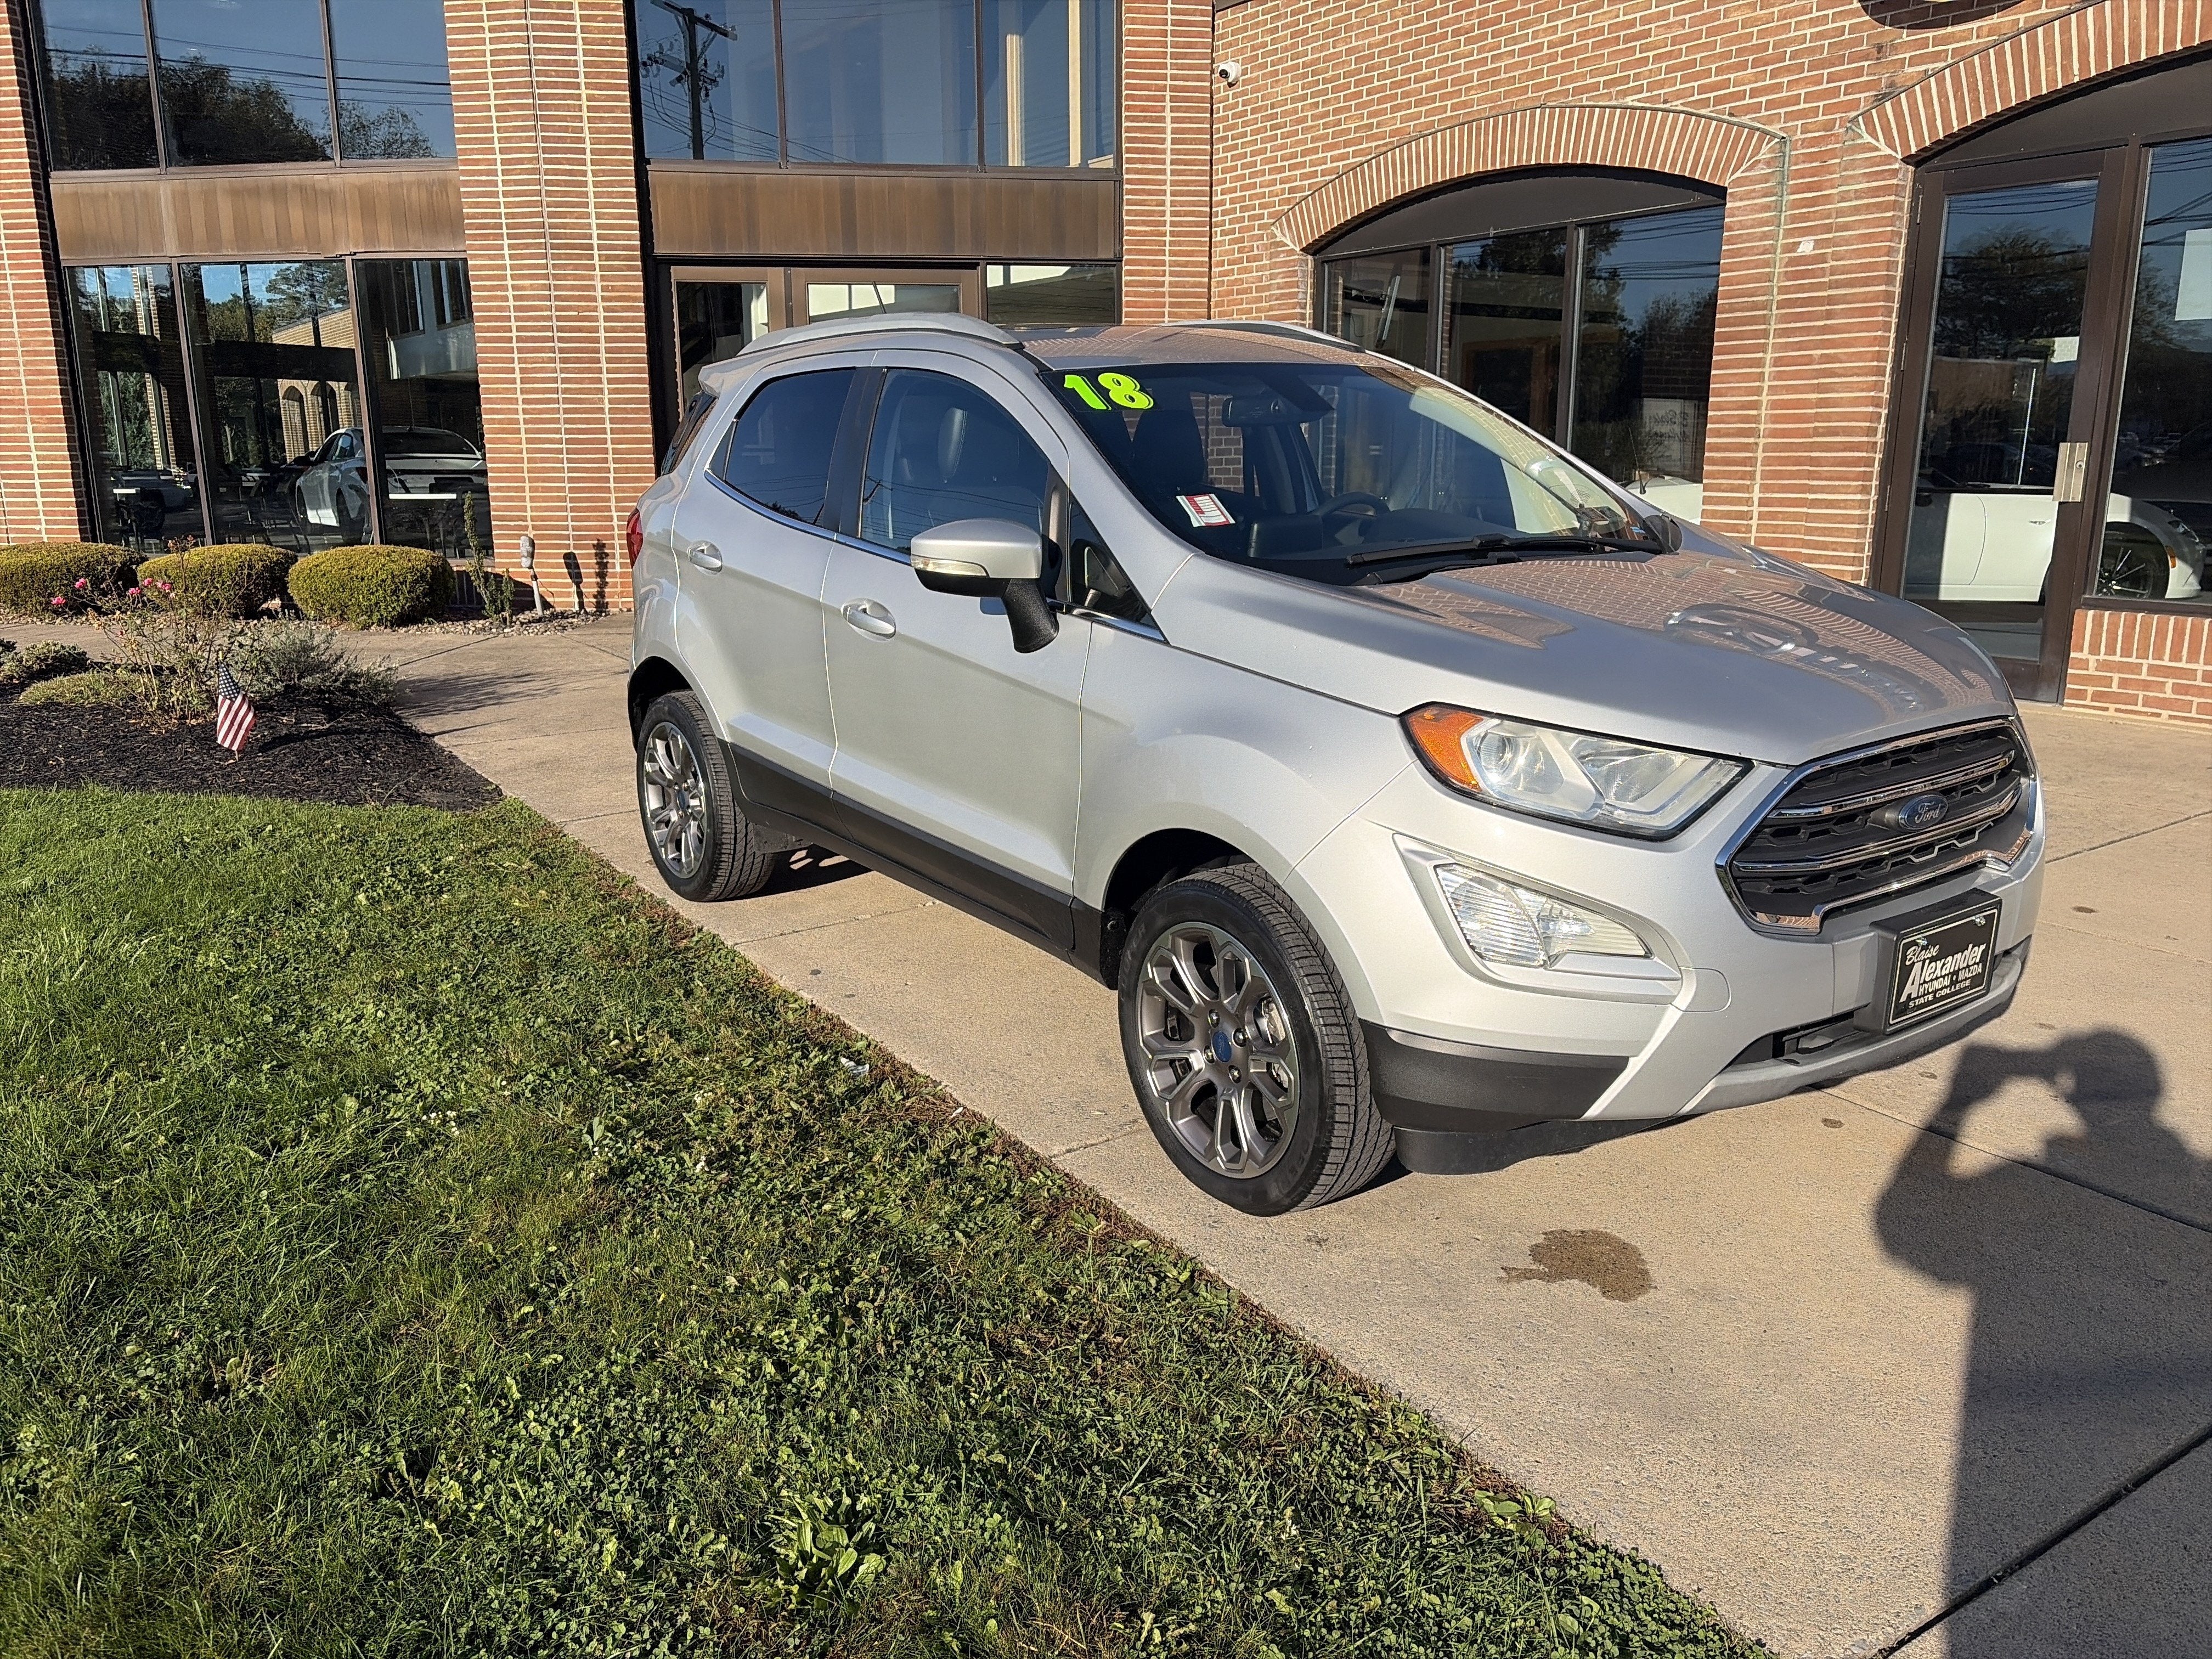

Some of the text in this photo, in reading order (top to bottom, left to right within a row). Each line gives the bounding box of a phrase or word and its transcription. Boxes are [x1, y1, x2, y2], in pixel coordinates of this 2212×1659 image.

[1064, 373, 1154, 410] 18
[1915, 802, 1942, 823] Ford
[1906, 944, 1939, 966] Blaise
[1899, 943, 1987, 1003] Alexander
[1918, 963, 1982, 997] HYUNDAI MAZDA
[1908, 979, 1971, 1008] STATE COLLEGE
